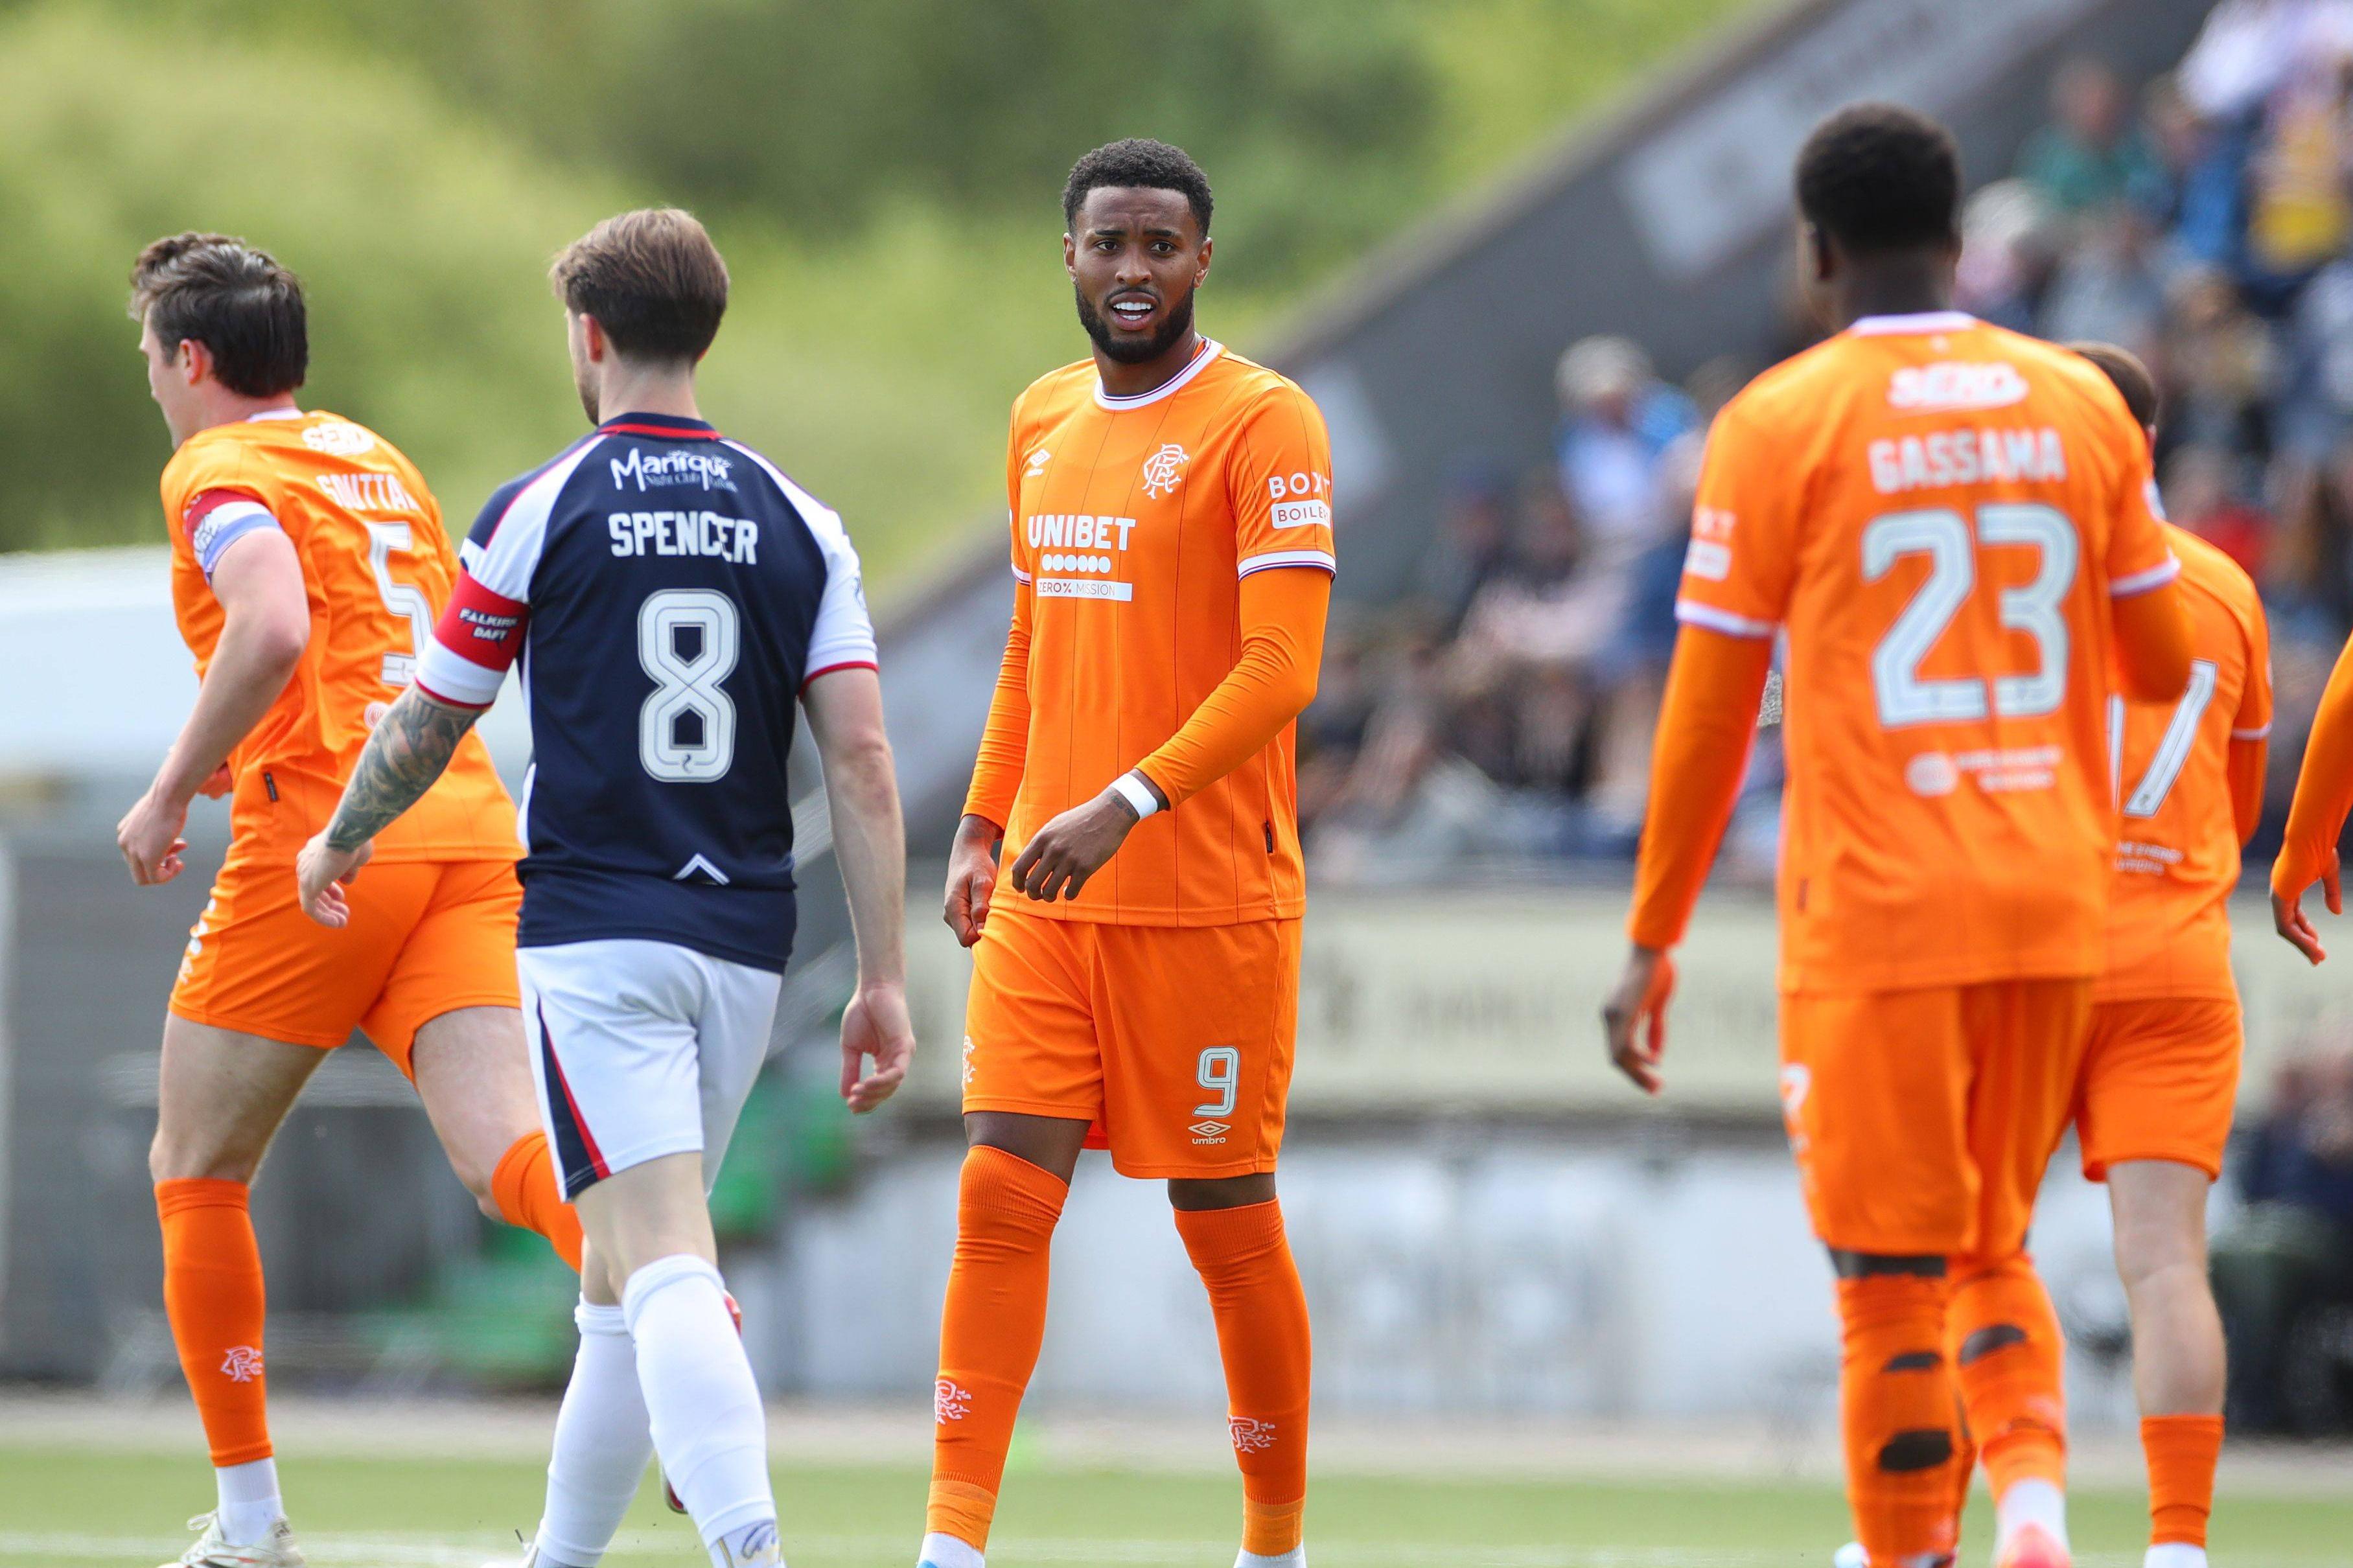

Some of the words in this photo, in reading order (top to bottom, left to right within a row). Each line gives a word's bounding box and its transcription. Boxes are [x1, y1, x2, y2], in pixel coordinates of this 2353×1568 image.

[1869, 428, 2069, 494] GASSAMA
[608, 511, 759, 564] SPENCER
[1028, 514, 1137, 551] UNIBET
[367, 520, 433, 687] 5
[1076, 583, 1116, 596] MSSION
[1859, 502, 2079, 730] 23
[637, 588, 741, 783] 8
[1192, 1045, 1240, 1118] 9
[1192, 1136, 1226, 1146] umbro
